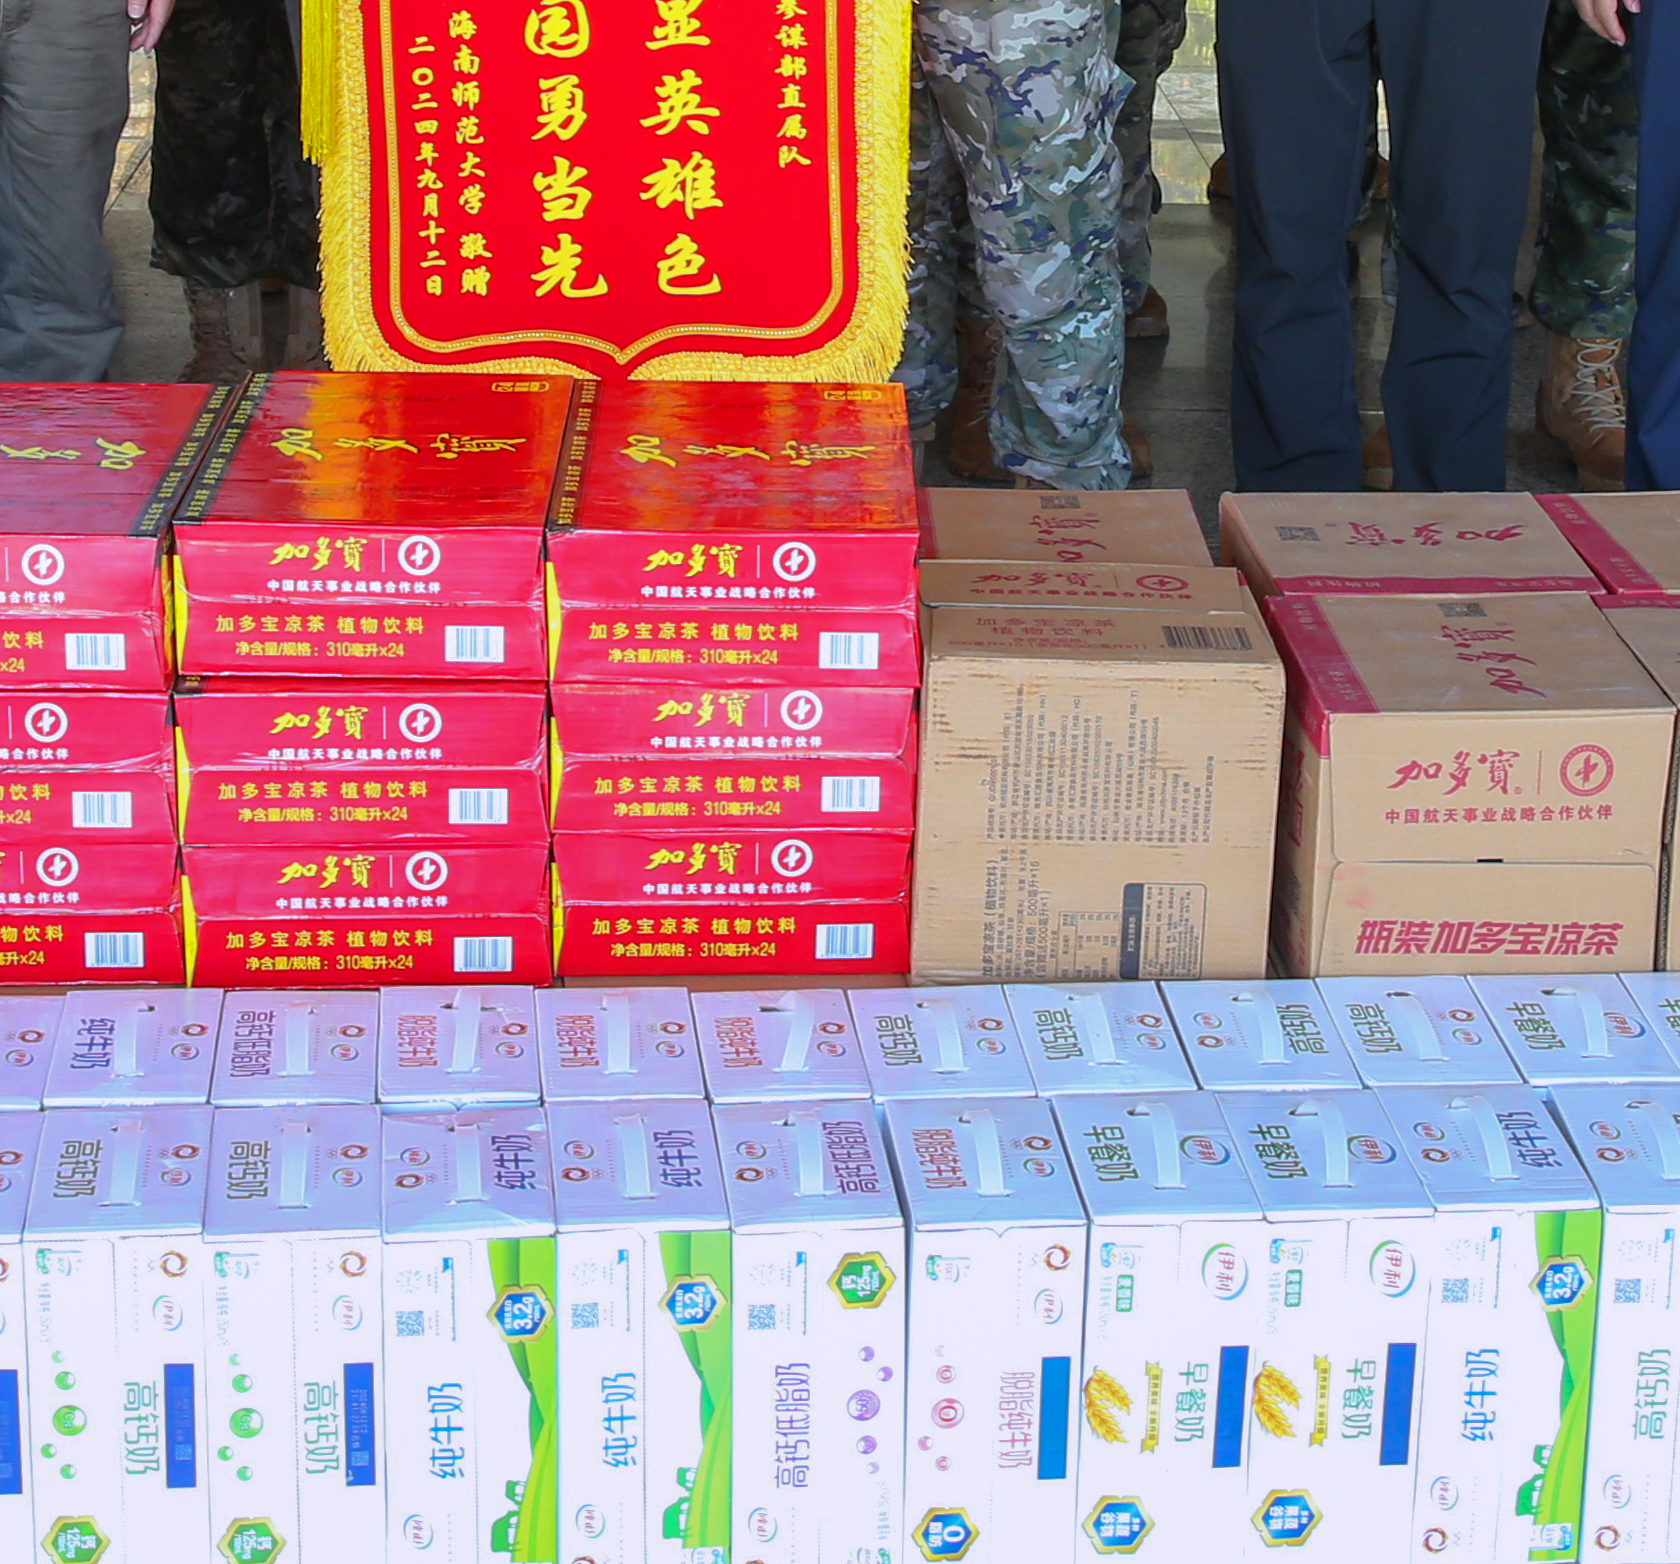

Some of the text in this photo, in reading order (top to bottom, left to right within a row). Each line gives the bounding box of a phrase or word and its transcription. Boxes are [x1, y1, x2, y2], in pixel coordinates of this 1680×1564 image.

[448, 10, 486, 216] 海南师范大学
[268, 580, 441, 594] 中国航天事业战略合作伙伴
[641, 586, 815, 598] 中国航天事业战略合作伙伴
[217, 616, 423, 633] 加多宝凉茶 植物饮料
[589, 623, 798, 640] 加多宝凉茶 植物饮料
[219, 782, 427, 798] 加多宝凉茶 植物饮料
[595, 776, 800, 793] 加多宝凉茶 植物饮料
[1384, 804, 1614, 825] 中国航天事业战略合作伙伴
[276, 896, 448, 909] 中国航天事业战略合作伙伴
[643, 883, 812, 895] 中国航天事业战略合作伙伴
[227, 931, 432, 948] 加多宝凉茶 植物饮料
[593, 918, 795, 934] 加多宝凉茶 植物饮料
[1354, 919, 1624, 957] 瓶装加多宝凉茶
[1175, 1362, 1209, 1443] 早餐奶
[1341, 1359, 1376, 1441] 早餐奶
[1461, 1348, 1500, 1442] 纯牛奶
[1633, 1348, 1671, 1441] 高钙奶
[123, 1380, 160, 1476] 高钙奶
[303, 1380, 340, 1476] 高钙奶
[427, 1382, 465, 1480] 纯牛奶
[602, 1372, 637, 1469] 纯牛奶
[774, 1363, 811, 1489] 高钙低脂奶
[998, 1371, 1035, 1469] 脱脂纯牛奶
